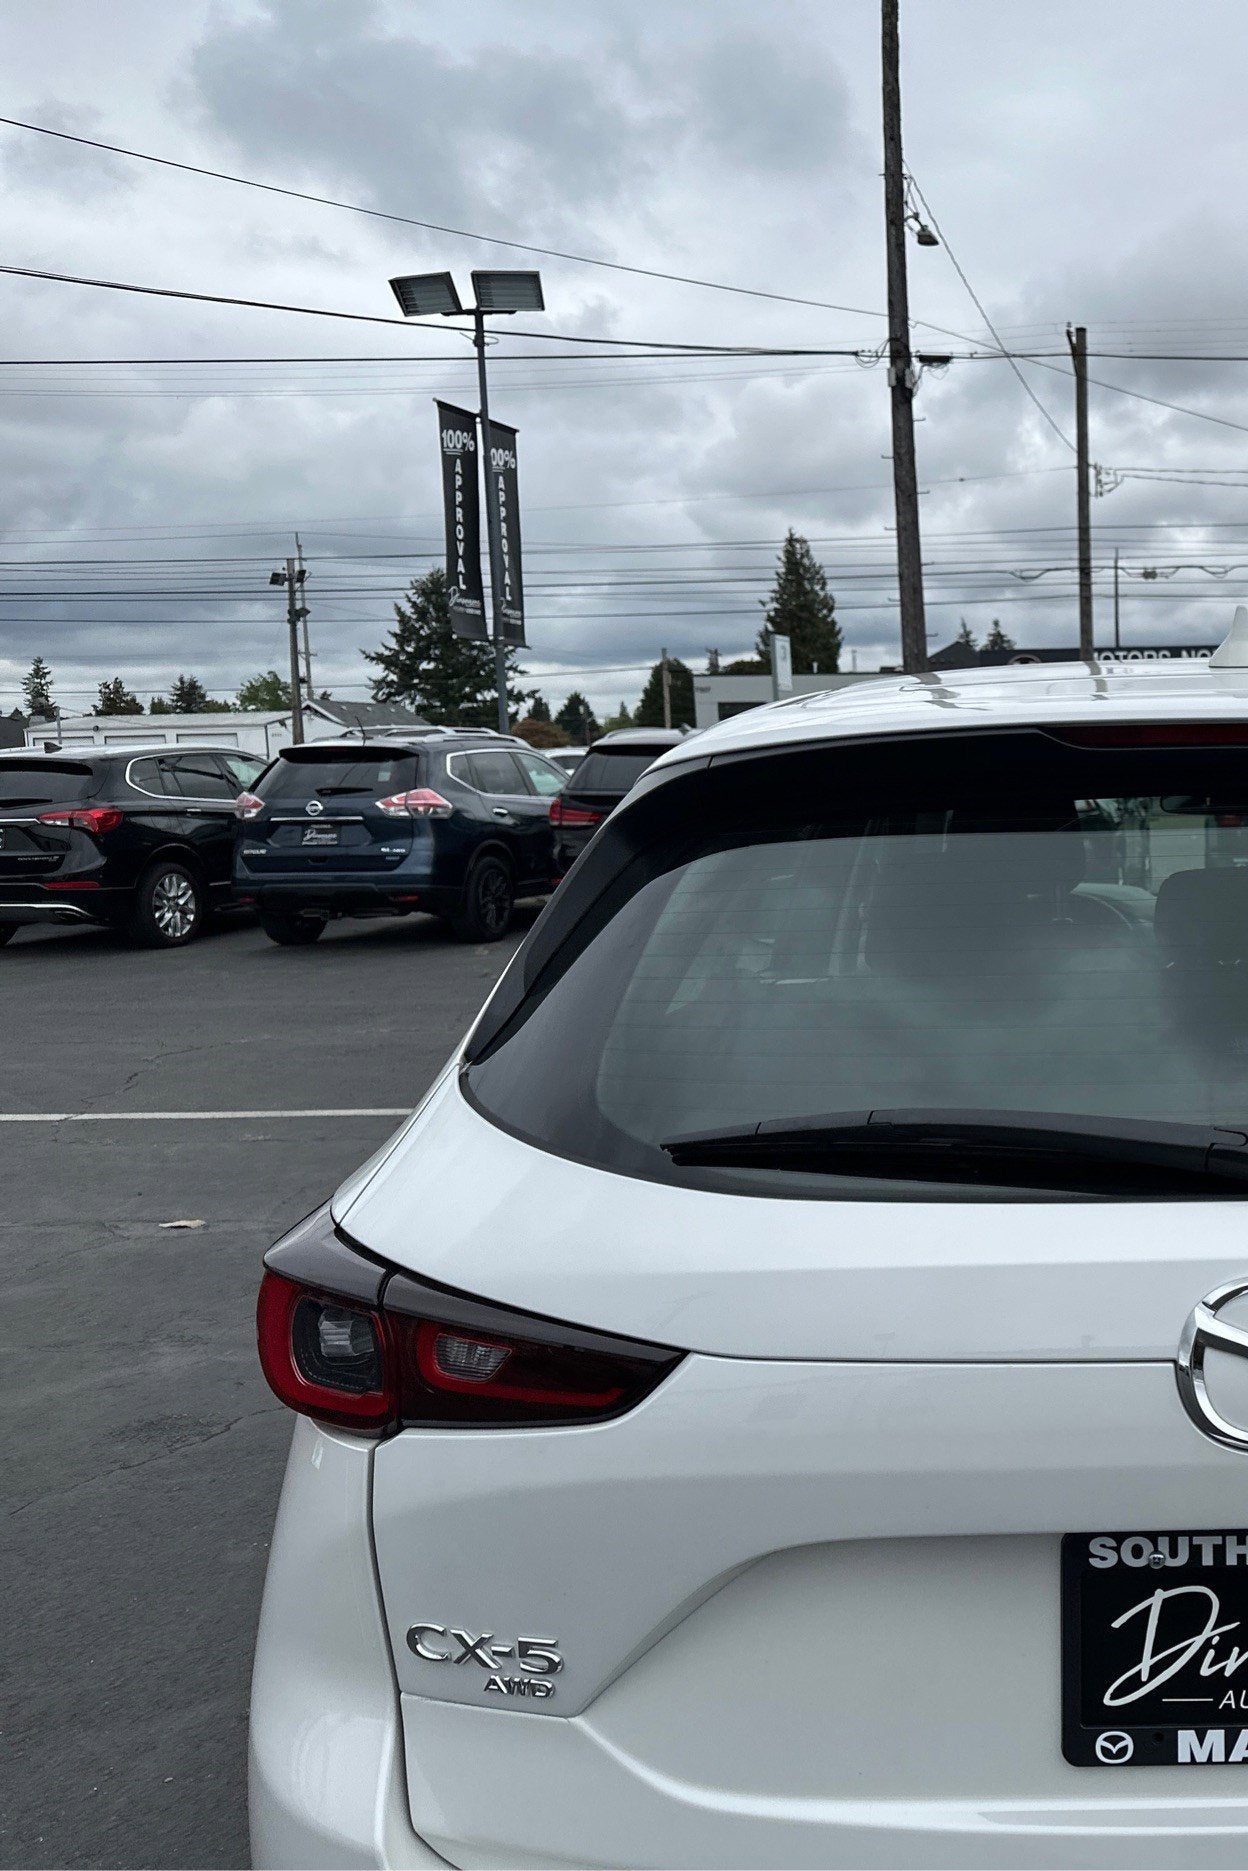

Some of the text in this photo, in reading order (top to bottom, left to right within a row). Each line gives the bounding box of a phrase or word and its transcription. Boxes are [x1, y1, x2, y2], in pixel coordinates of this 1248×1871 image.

[441, 429, 475, 452] 100%
[490, 448, 516, 469] 00%
[454, 458, 467, 590] APPROVAL
[498, 475, 512, 601] APPROVAL
[406, 1622, 565, 1675] CX-5
[484, 1675, 556, 1698] AWD
